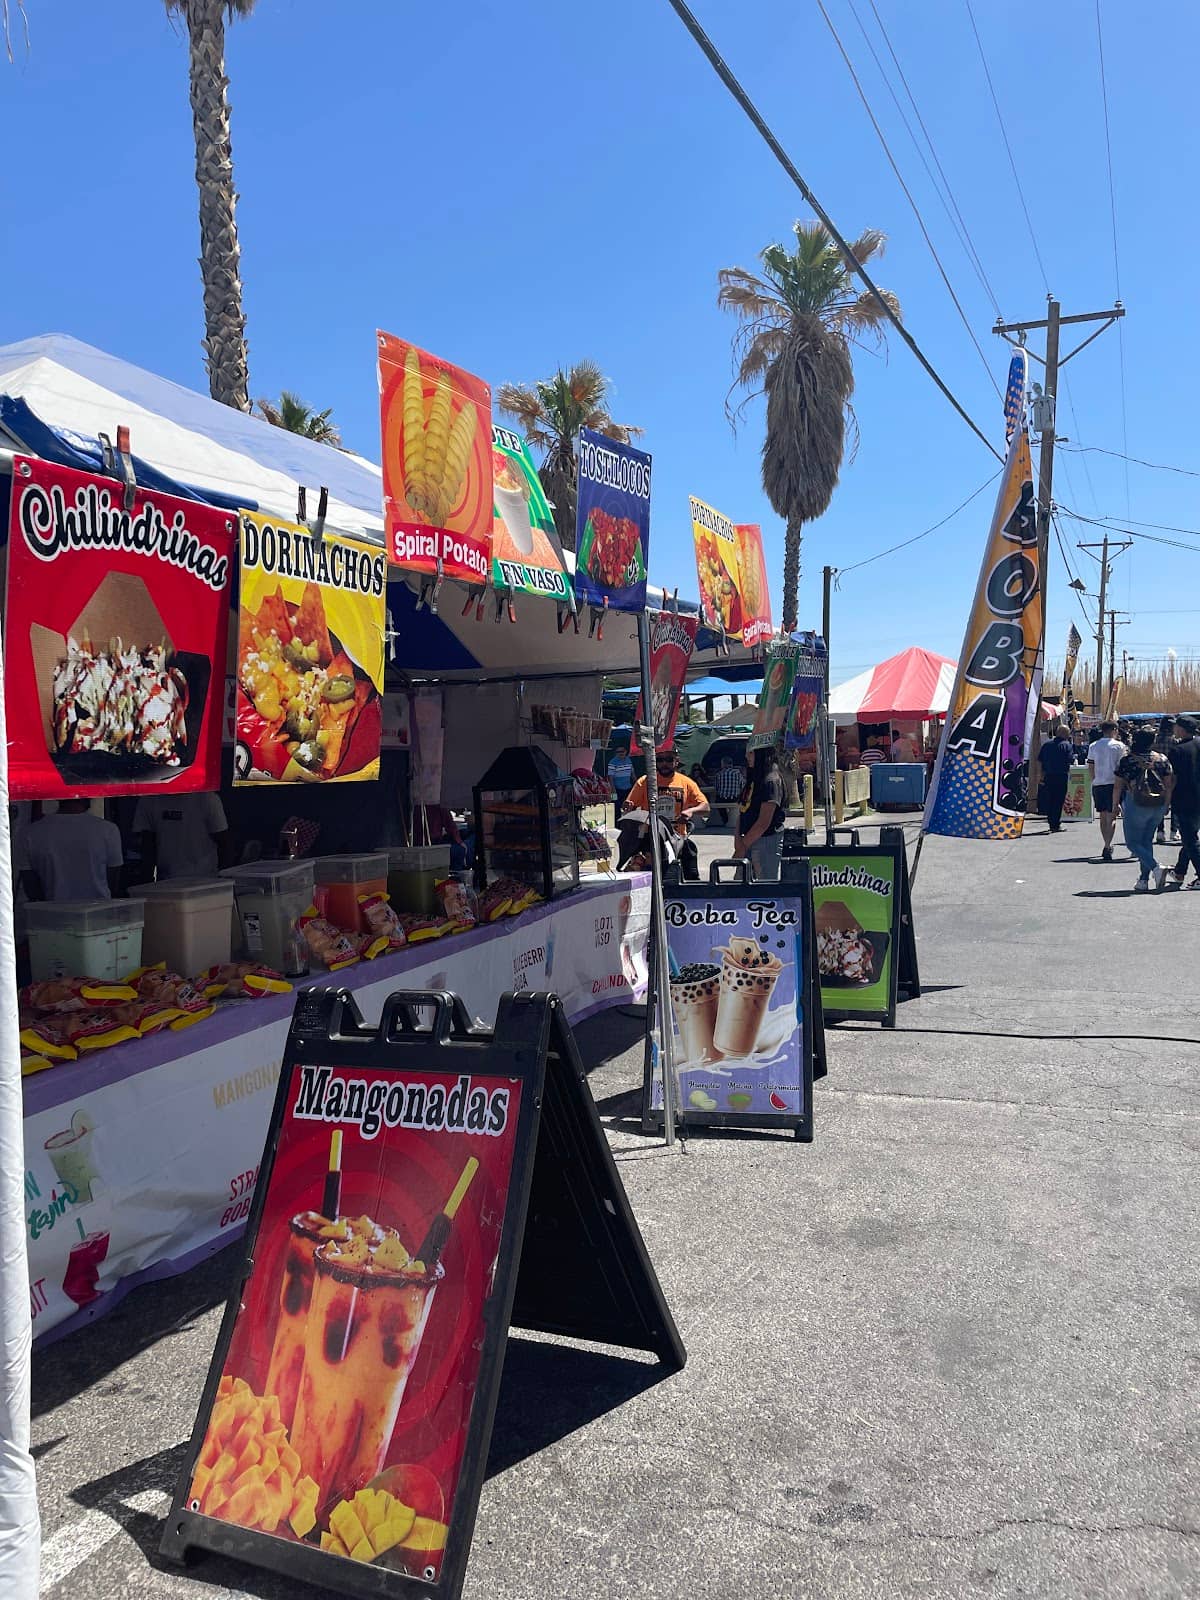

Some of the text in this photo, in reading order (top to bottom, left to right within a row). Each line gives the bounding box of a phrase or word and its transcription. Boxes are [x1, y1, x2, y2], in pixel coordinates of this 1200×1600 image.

[581, 440, 650, 499] TOSTILOCOS
[20, 484, 228, 591] Chilindrinas
[241, 520, 387, 598] DORINACHOS
[394, 529, 488, 576] Spiral Potato
[499, 560, 566, 595] EN VASO
[664, 901, 799, 929] Boba Tea
[213, 1059, 282, 1109] MANGONA
[294, 1066, 510, 1140] Mangonadas
